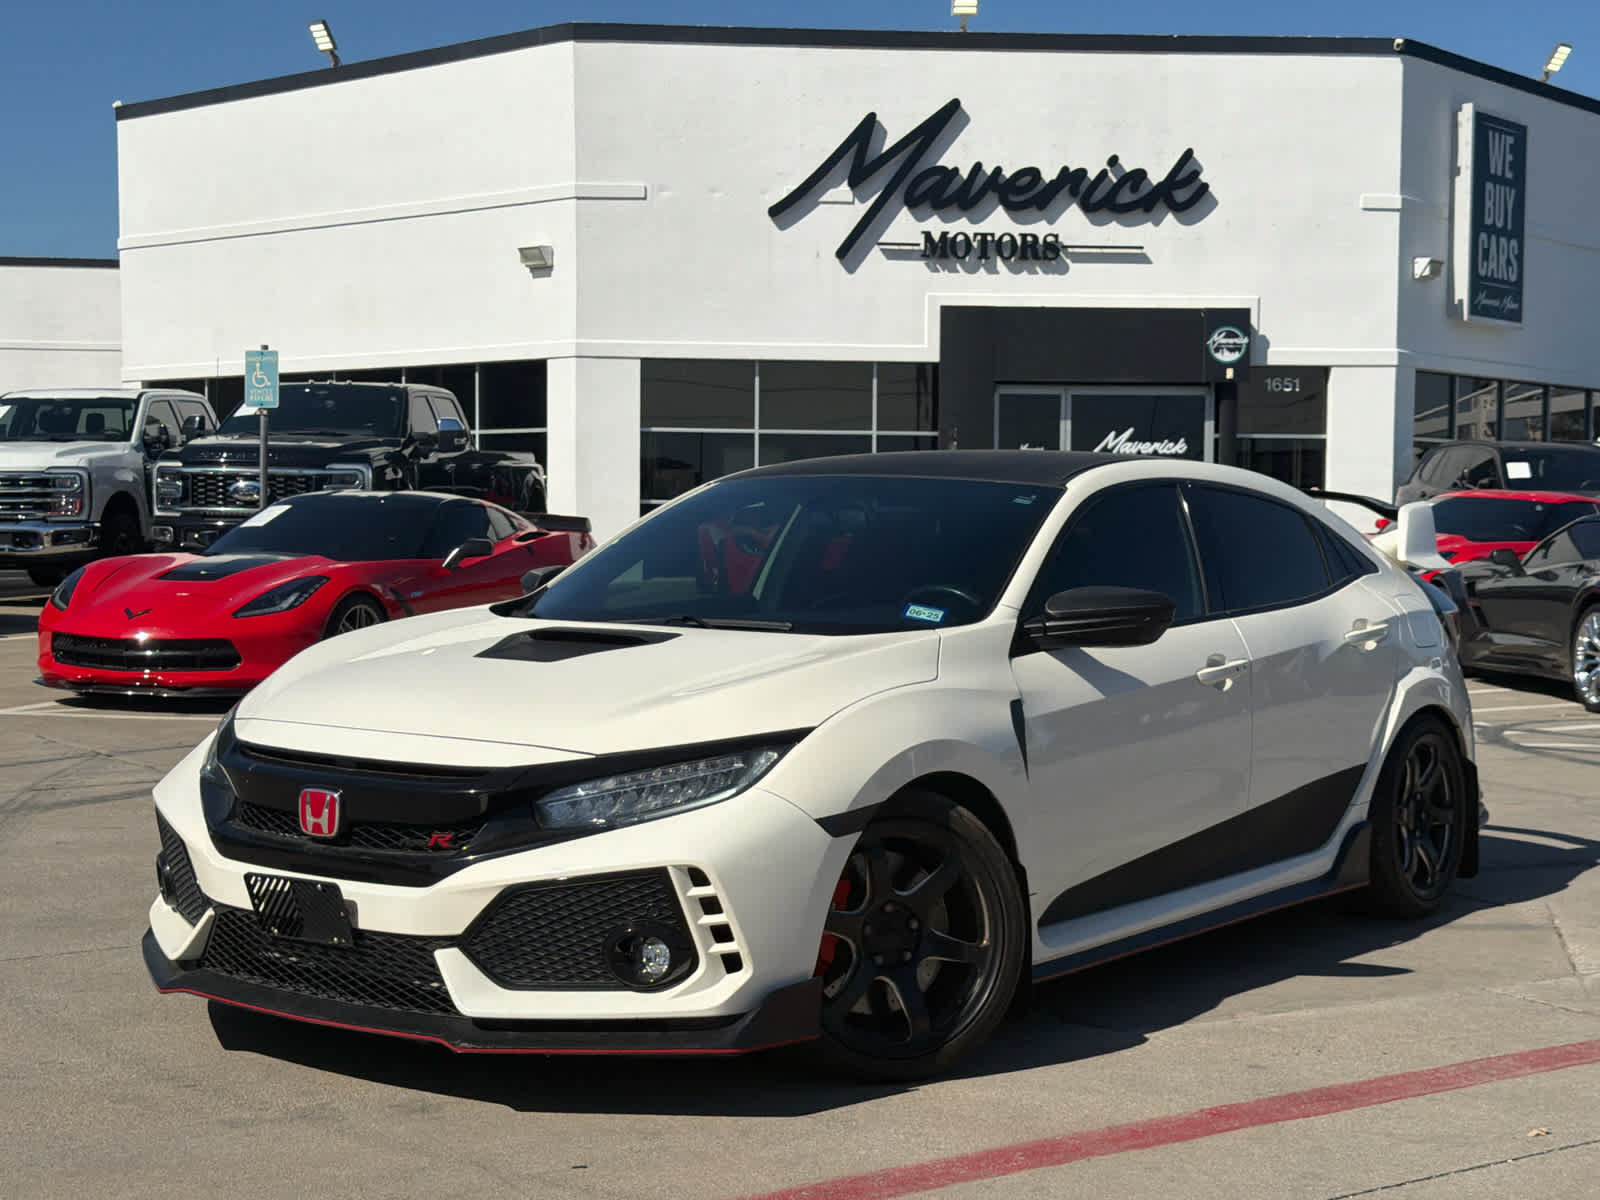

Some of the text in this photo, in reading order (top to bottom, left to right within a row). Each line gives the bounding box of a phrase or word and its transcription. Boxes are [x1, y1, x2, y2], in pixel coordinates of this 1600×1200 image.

[1488, 130, 1514, 179] WE
[768, 98, 1208, 260] Maverick
[1484, 182, 1516, 230] BUY
[920, 231, 1061, 261] MOTORS
[1478, 232, 1518, 282] CARS
[1265, 377, 1300, 392] 1651
[1093, 427, 1187, 454] Maverick
